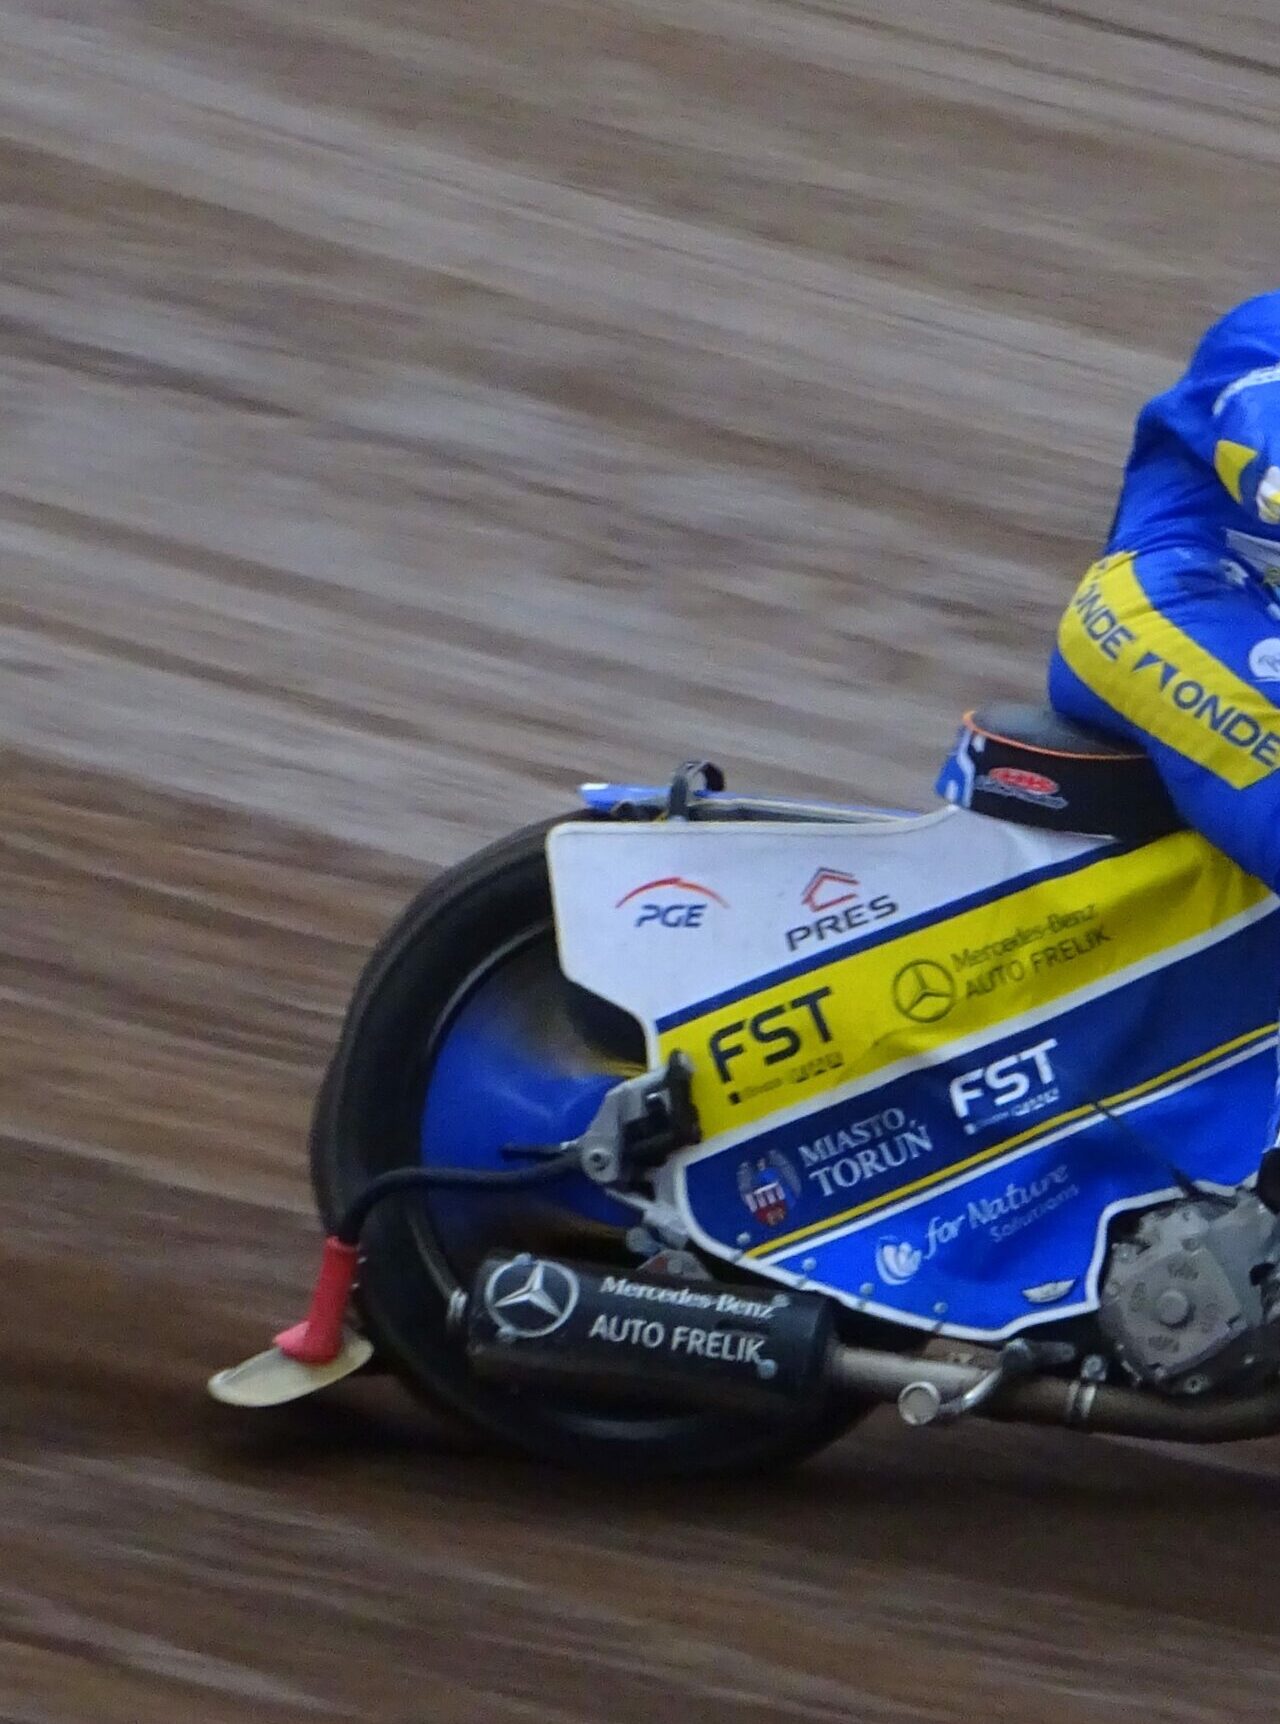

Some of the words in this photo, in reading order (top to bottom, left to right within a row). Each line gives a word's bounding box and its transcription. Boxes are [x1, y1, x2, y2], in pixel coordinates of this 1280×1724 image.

[634, 903, 707, 928] PGE
[785, 894, 899, 951] PRES
[965, 959, 1025, 999] AUTO
[1030, 924, 1112, 974] FRELIK
[709, 985, 833, 1084] FST
[949, 1038, 1058, 1118] FST
[798, 1107, 906, 1168] MIASTO
[923, 1215, 966, 1261] for
[966, 1164, 1069, 1230] Nature
[600, 1275, 777, 1320] Mercedes-Benz
[588, 1313, 666, 1350] AUTO
[670, 1325, 768, 1365] FRELIK
